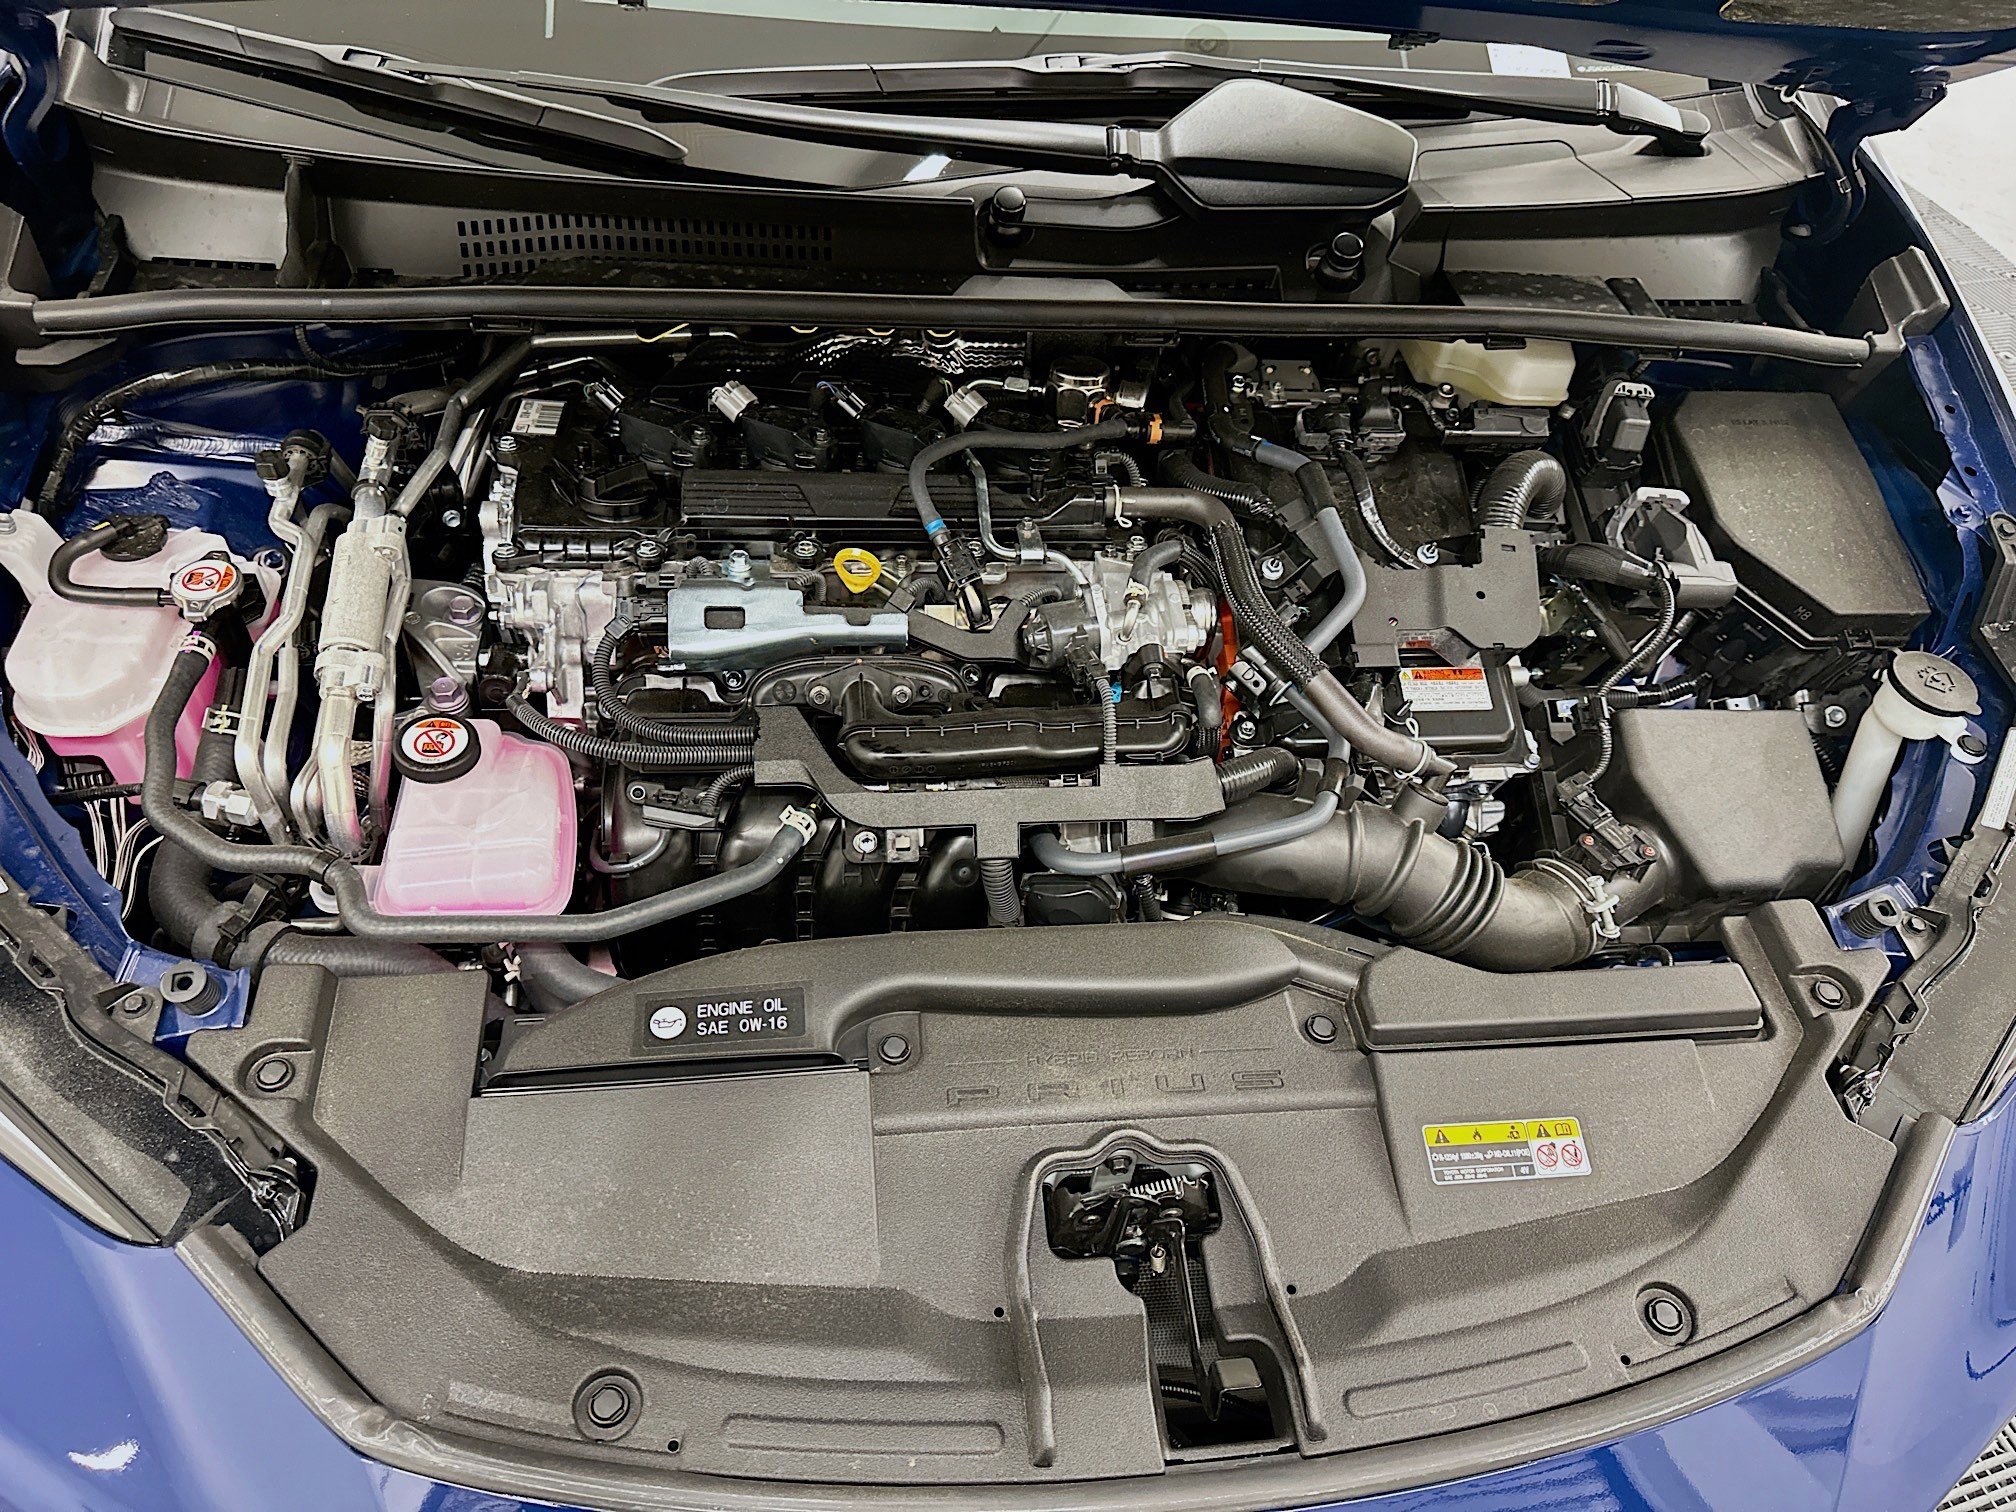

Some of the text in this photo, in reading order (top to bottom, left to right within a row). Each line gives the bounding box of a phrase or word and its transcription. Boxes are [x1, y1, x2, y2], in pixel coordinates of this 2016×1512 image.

[697, 998, 788, 1018] ENGINE OIL
[697, 1016, 788, 1036] SAE 0W-16
[946, 1069, 1284, 1105] PRIUS
